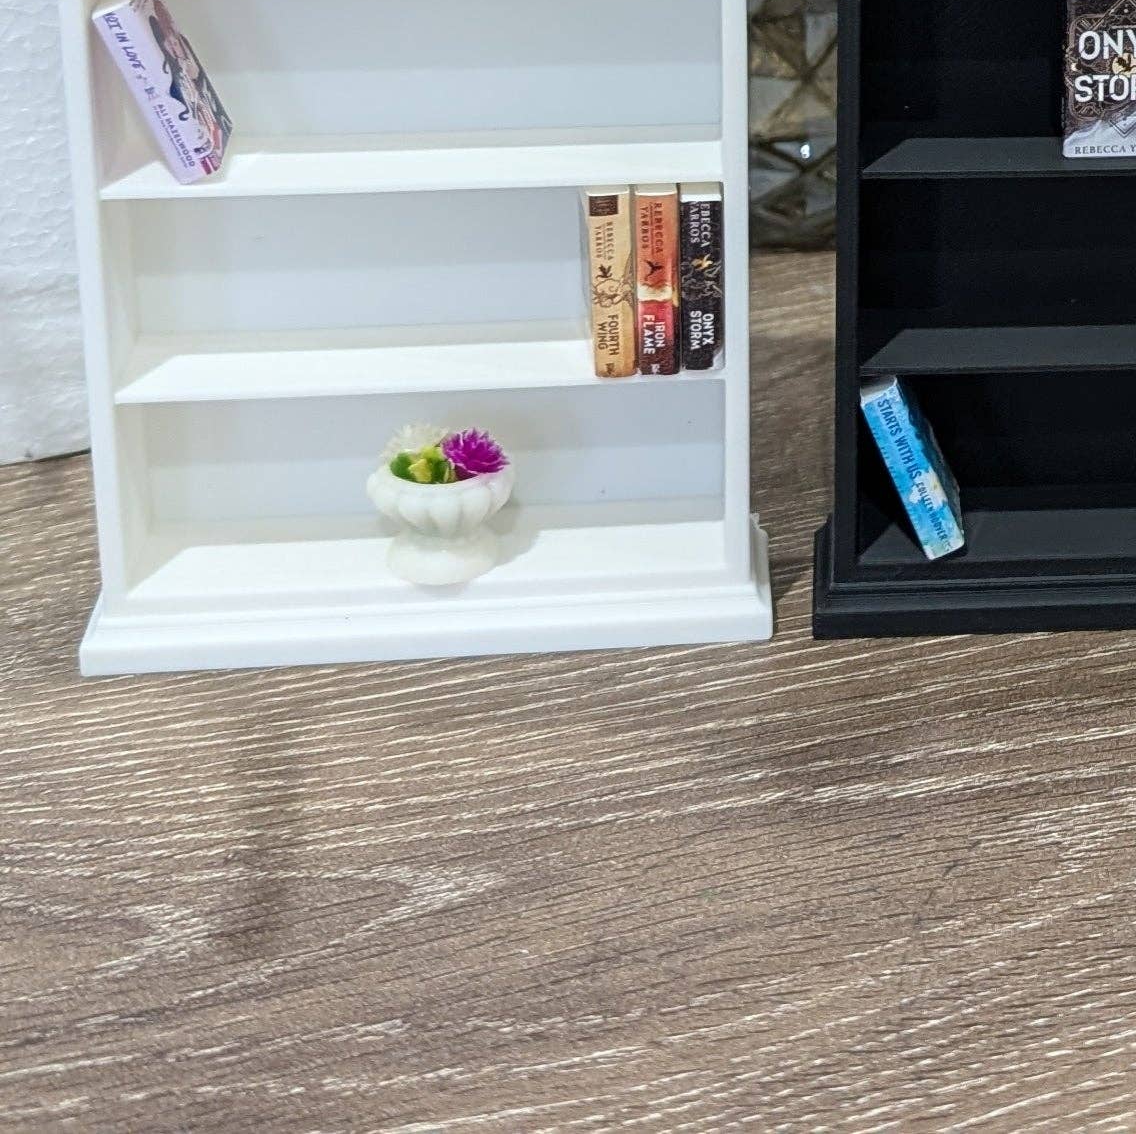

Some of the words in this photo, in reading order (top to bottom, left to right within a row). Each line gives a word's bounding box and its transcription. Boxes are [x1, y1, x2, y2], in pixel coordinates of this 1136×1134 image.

[116, 32, 131, 43] IN
[123, 46, 146, 72] LOVE
[1075, 145, 1126, 155] REBECCA
[640, 206, 650, 250] YARROS
[653, 202, 664, 254] REBECCA
[700, 203, 711, 248] EBECCA
[597, 322, 607, 351] WING
[608, 314, 620, 356] FOURTH
[643, 314, 656, 355] FLAME
[655, 321, 665, 348] IRON
[690, 310, 702, 350] STORM
[702, 313, 715, 345] ONYX
[877, 399, 902, 436] STARTS
[895, 434, 914, 465] WITH
[906, 463, 922, 480] US
